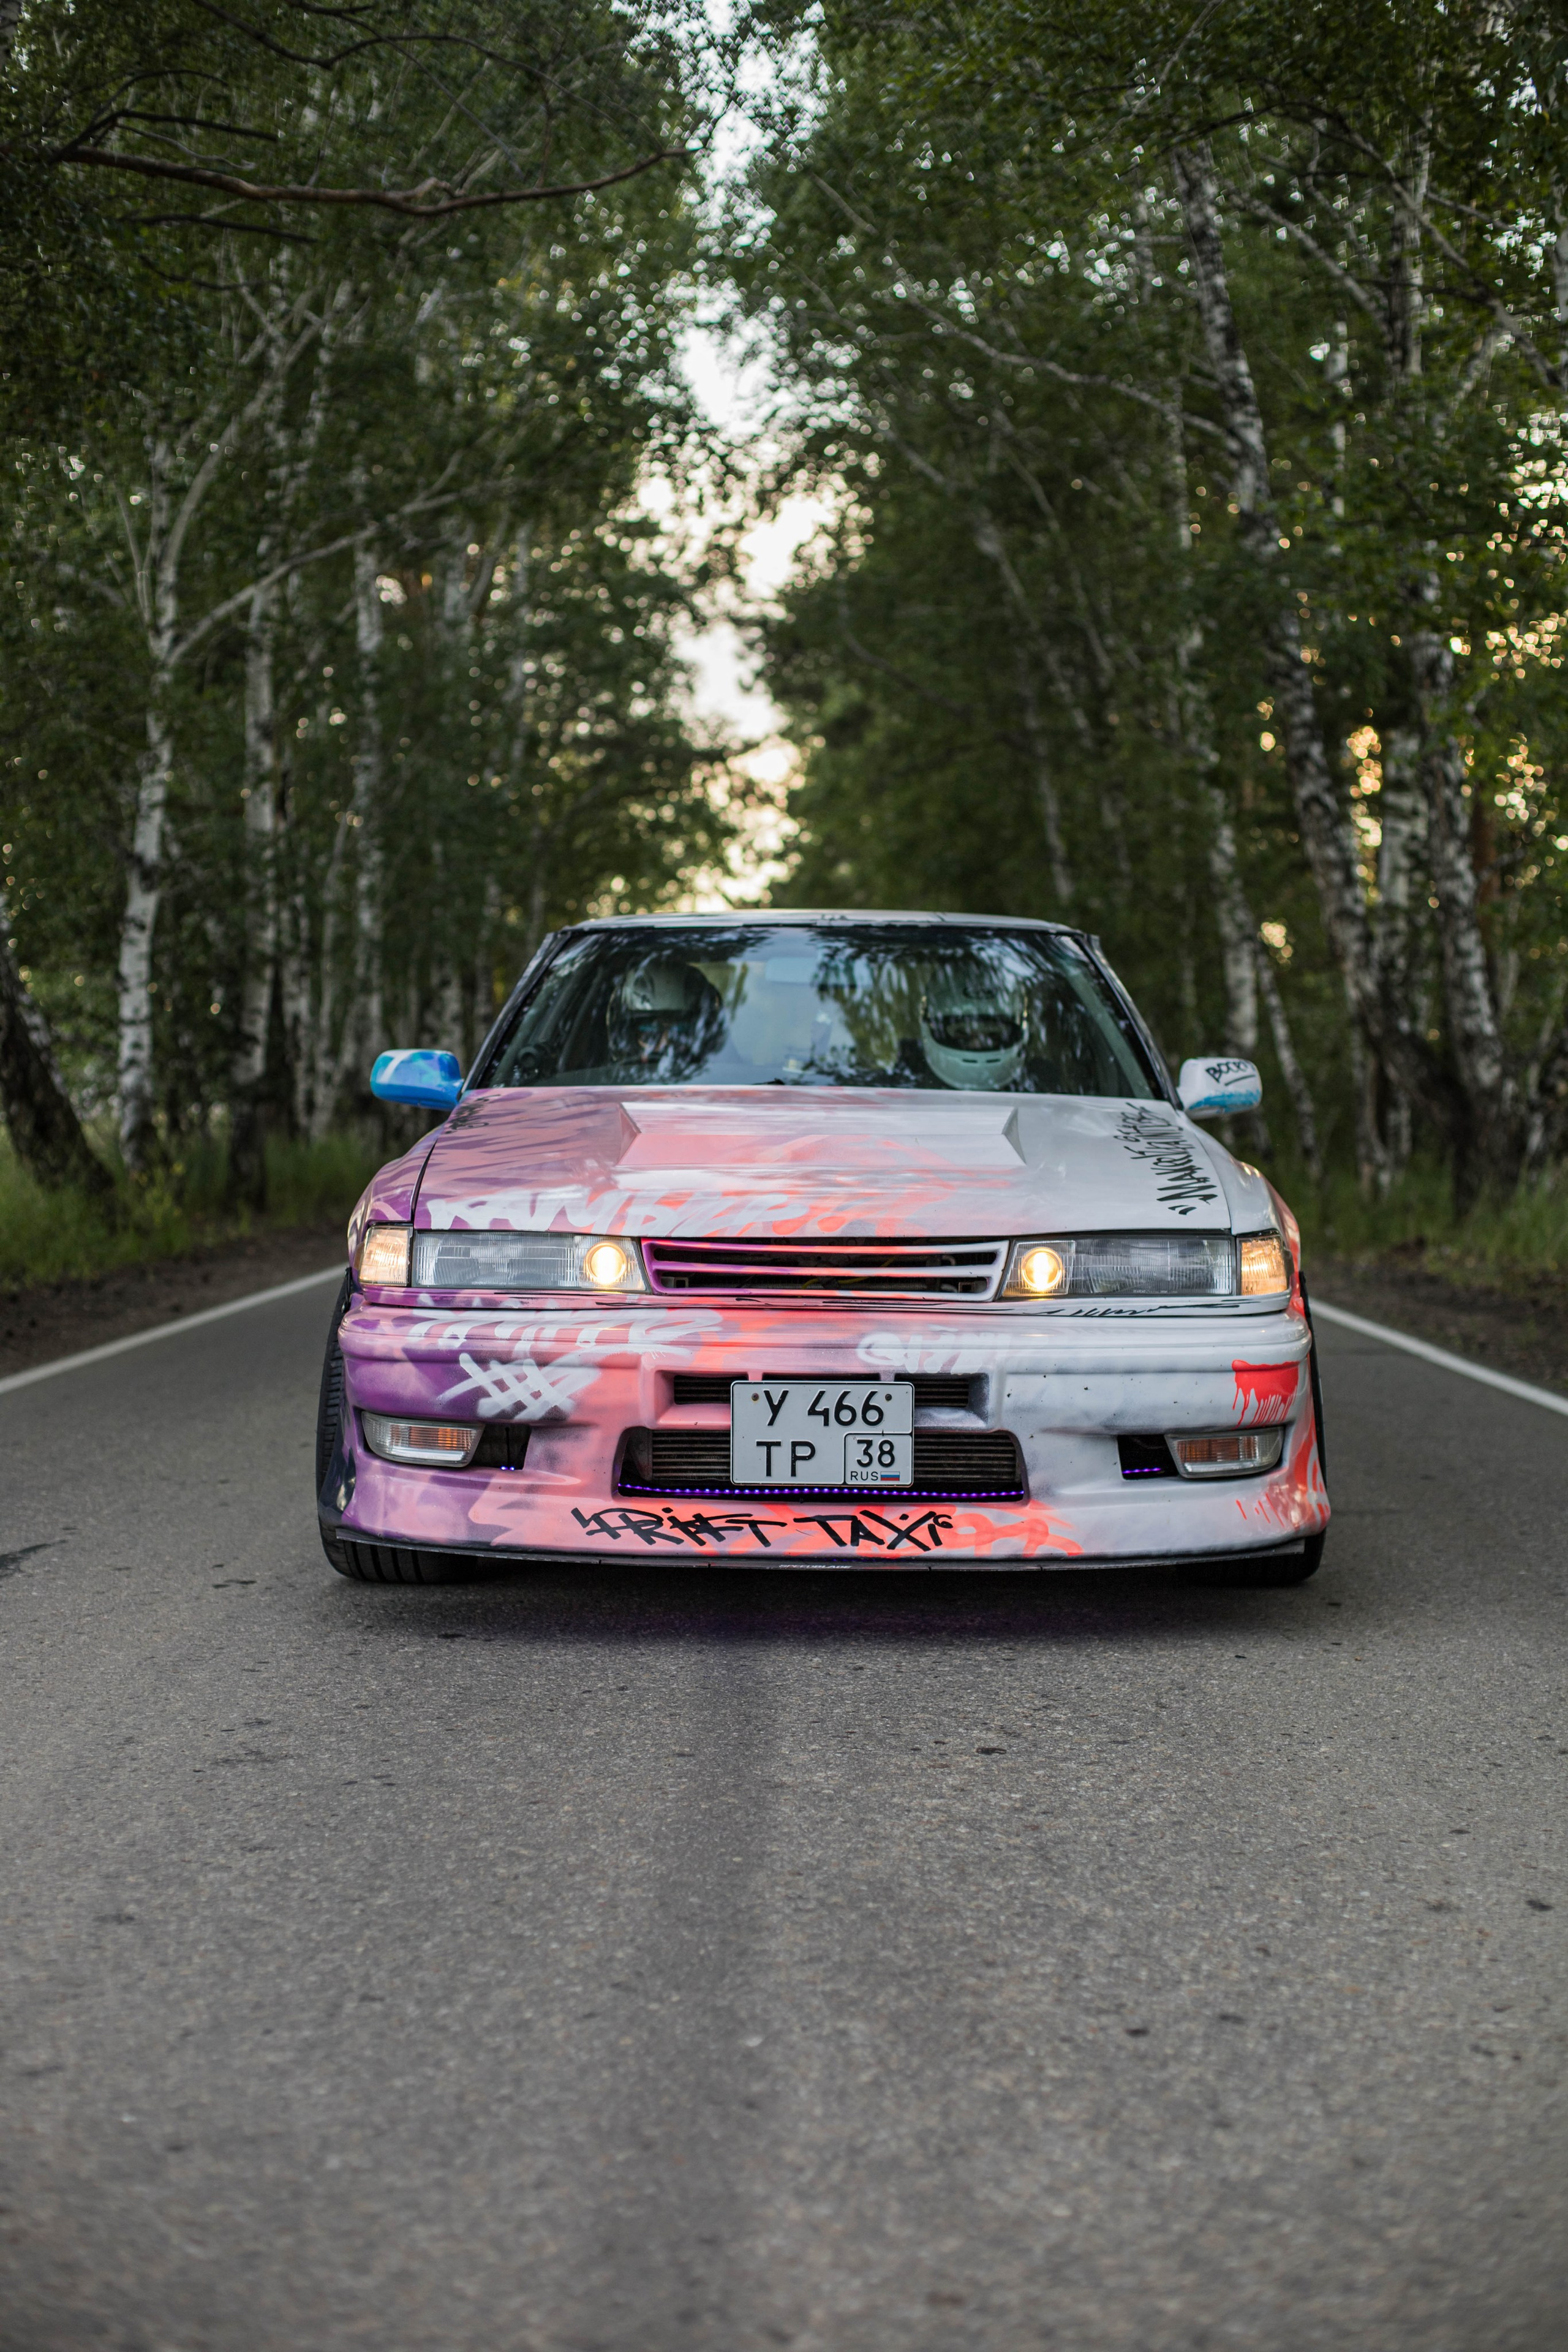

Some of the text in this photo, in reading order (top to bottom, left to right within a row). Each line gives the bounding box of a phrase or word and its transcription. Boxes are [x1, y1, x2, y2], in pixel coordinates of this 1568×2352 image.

[807, 1390, 884, 1427] 466
[856, 1439, 895, 1468] 38
[850, 1471, 879, 1481] RUS
